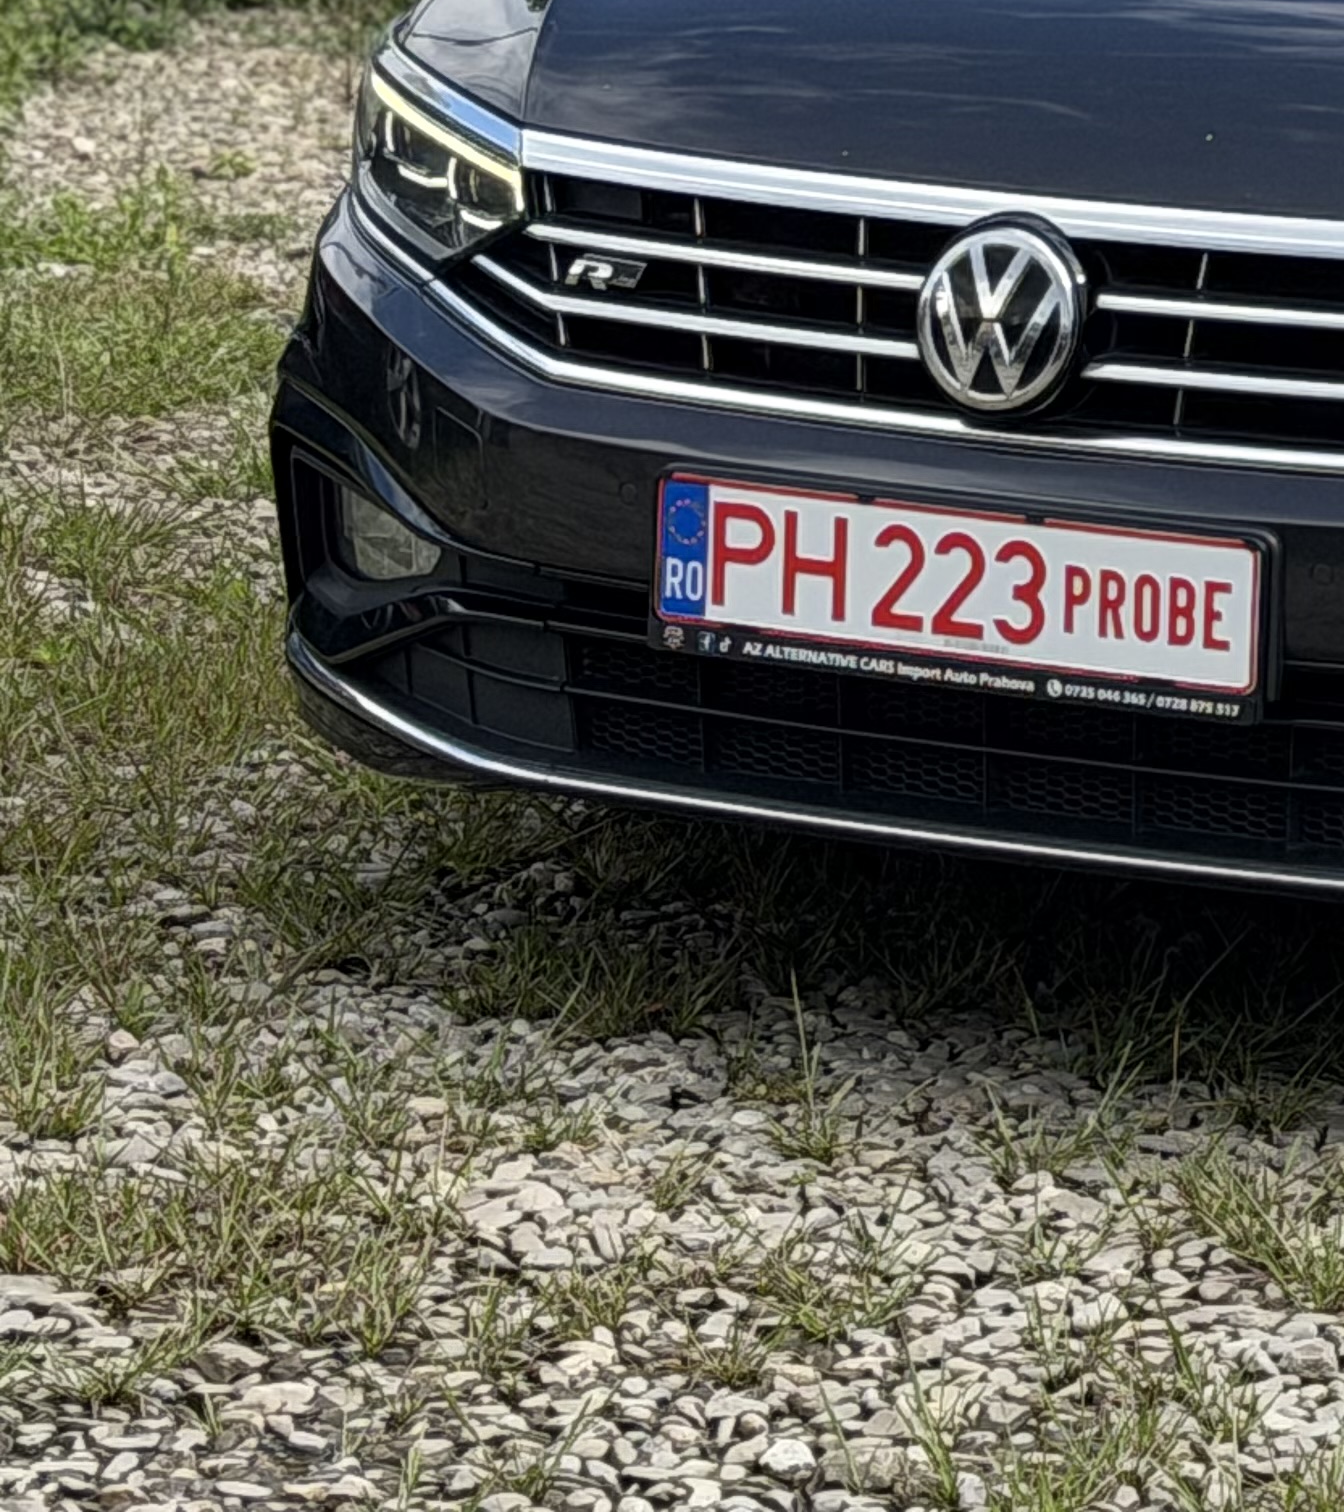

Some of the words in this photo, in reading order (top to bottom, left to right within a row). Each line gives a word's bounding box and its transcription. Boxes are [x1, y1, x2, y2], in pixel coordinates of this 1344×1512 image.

[564, 259, 614, 291] R
[664, 556, 704, 601] RO
[711, 500, 849, 622] PH
[871, 524, 1047, 646] 223
[1063, 564, 1233, 652] PROBE
[742, 640, 763, 656] AZ
[764, 642, 858, 669] ALTERNATIVE
[859, 656, 895, 675] CARS
[897, 661, 942, 681] Import
[943, 666, 977, 685] Auto
[979, 672, 1035, 693] Prahova
